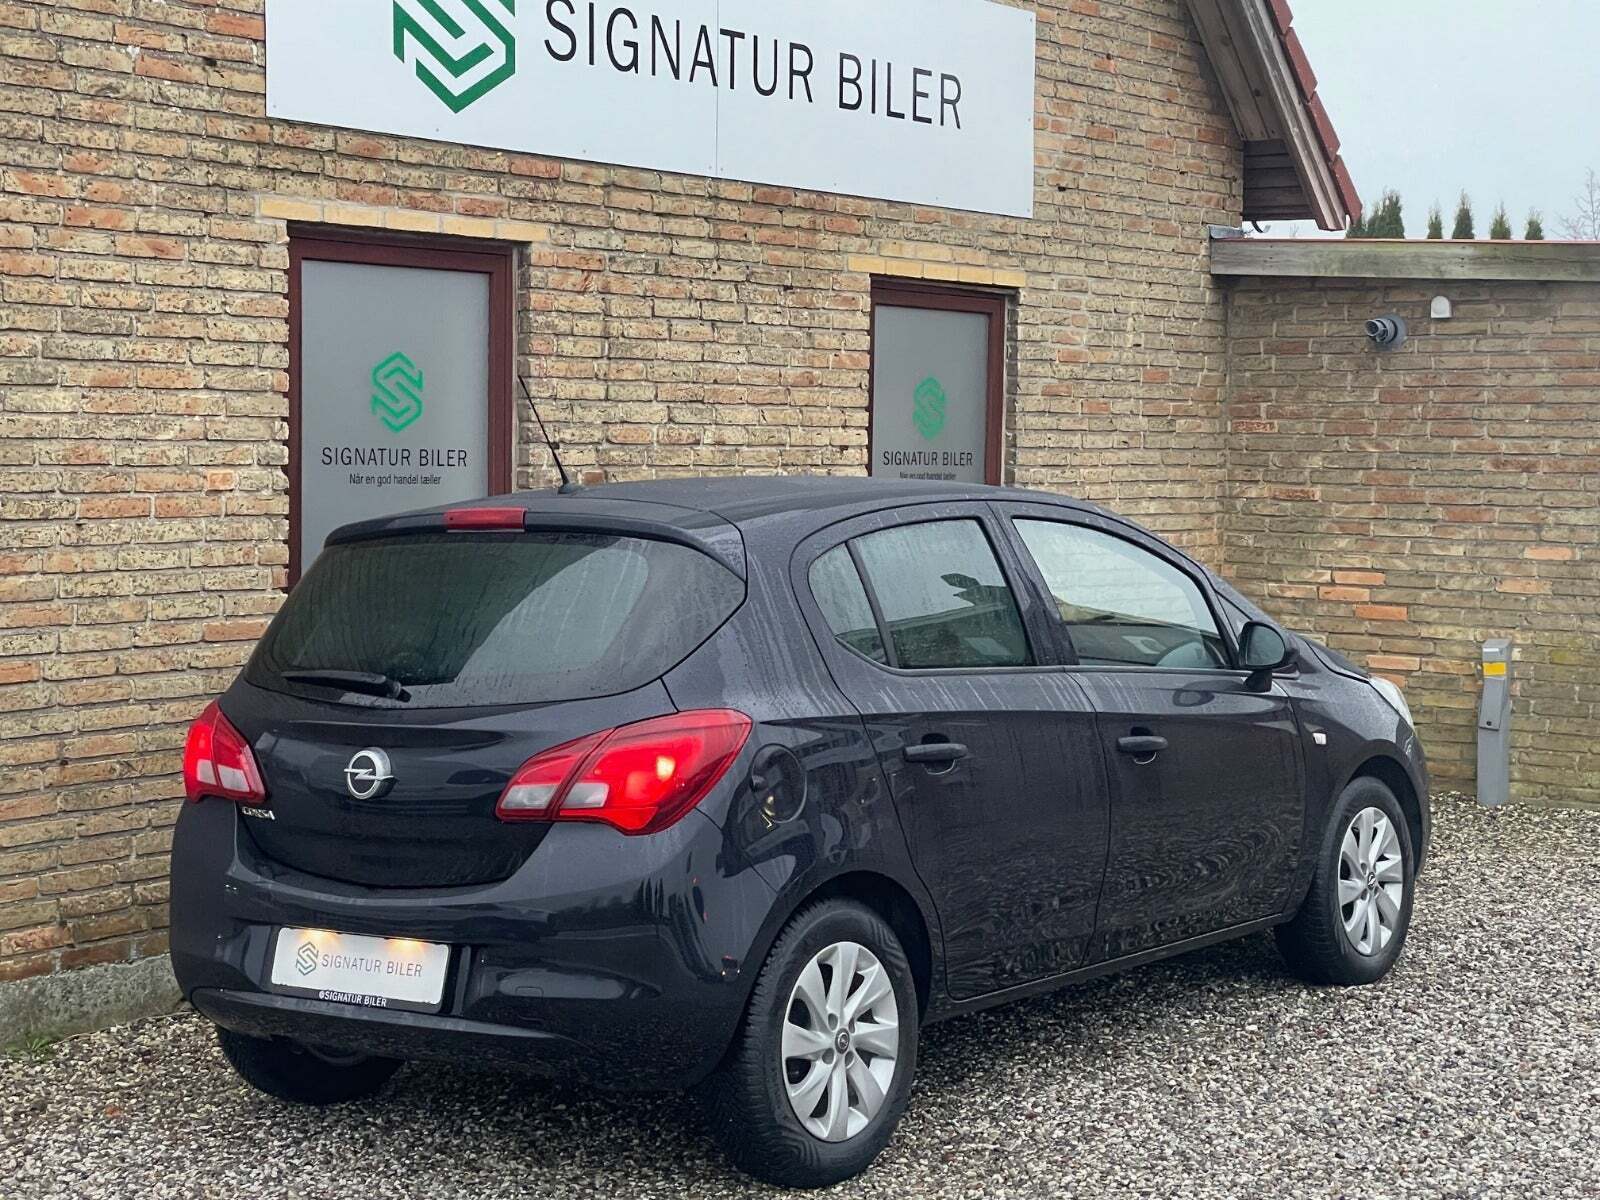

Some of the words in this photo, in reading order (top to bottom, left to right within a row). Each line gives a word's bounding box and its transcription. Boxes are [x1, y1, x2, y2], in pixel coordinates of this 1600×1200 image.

[544, 0, 815, 104] SIGNATUR
[837, 52, 962, 130] BILER
[321, 447, 411, 466] SIGNATUR
[419, 449, 467, 467] BILER
[883, 451, 938, 466] SIGNATUR
[942, 452, 973, 466] BILER
[366, 476, 376, 485] en
[377, 474, 392, 487] god
[394, 474, 419, 485] handel
[322, 954, 382, 972] SIGNATUR
[386, 962, 423, 977] BILER
[364, 996, 387, 1007] BILER
